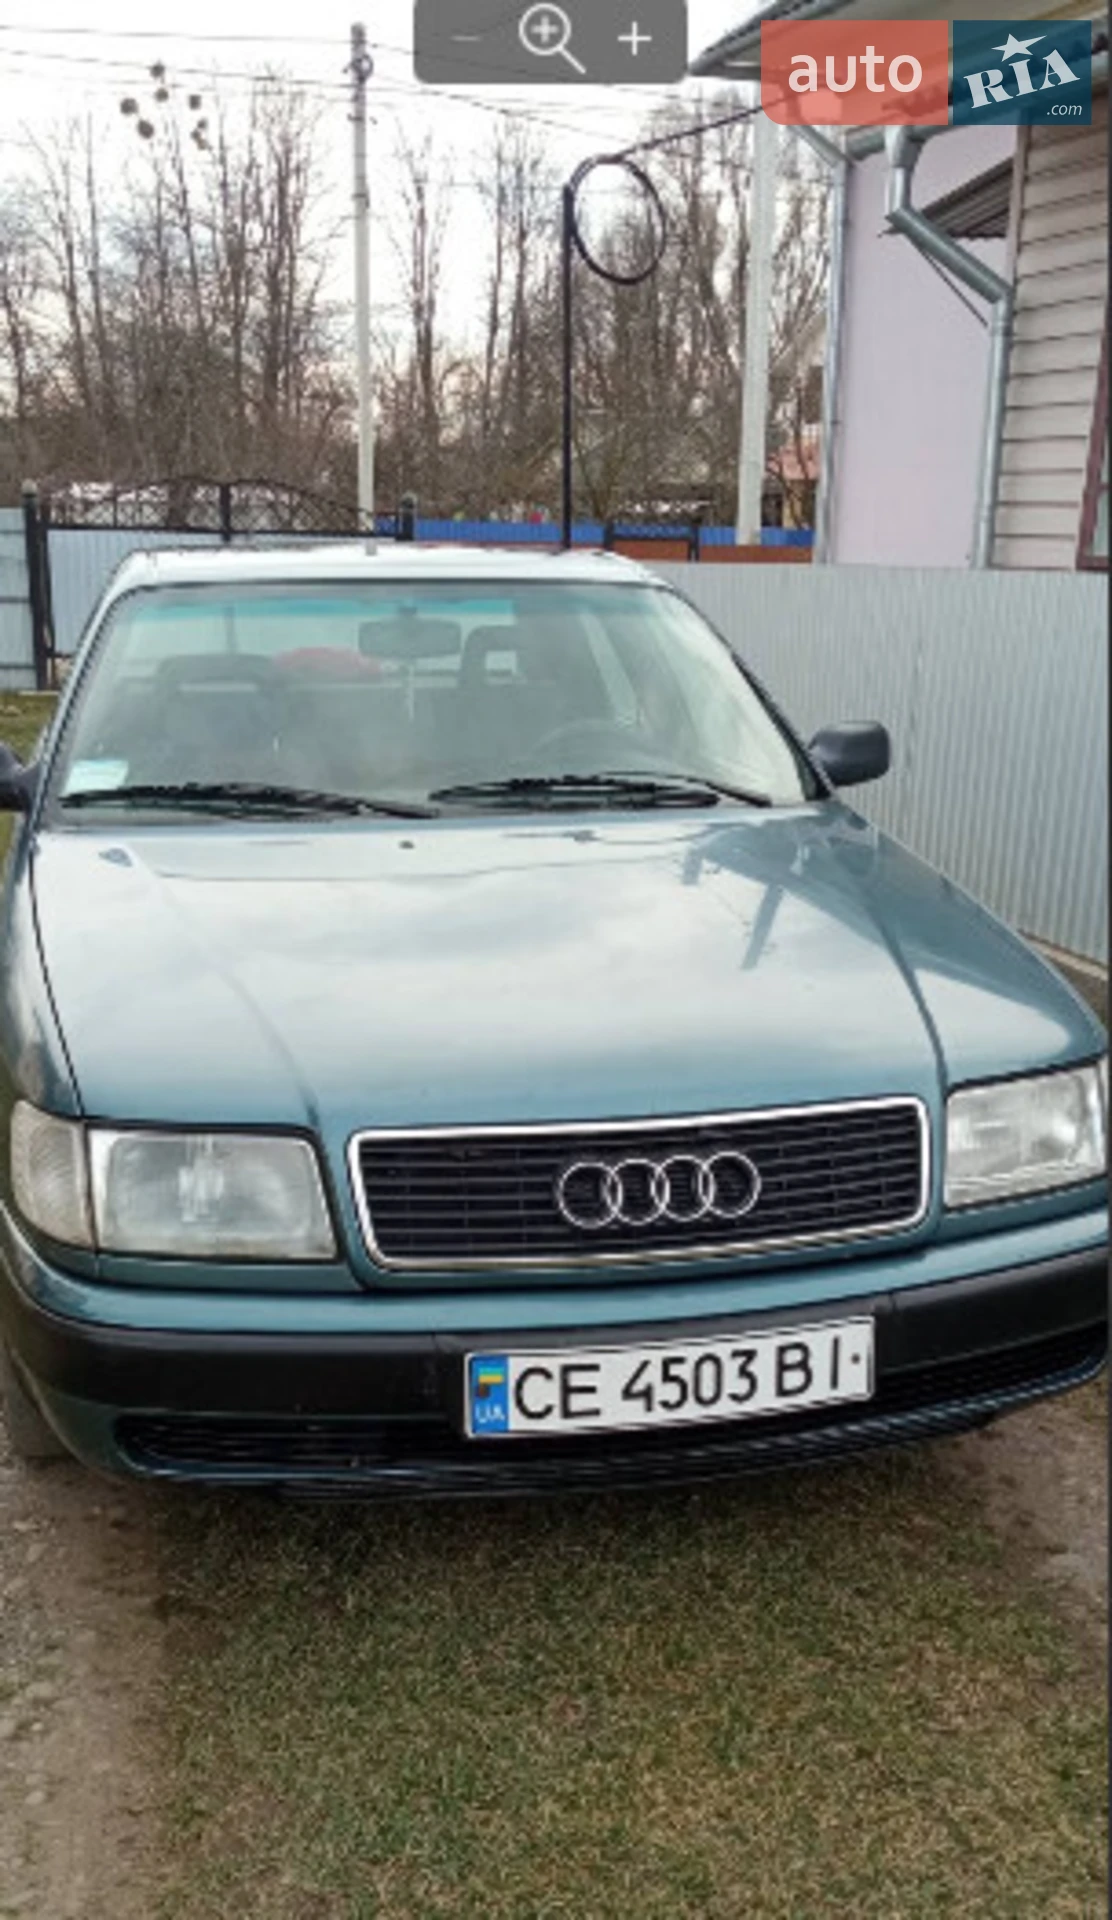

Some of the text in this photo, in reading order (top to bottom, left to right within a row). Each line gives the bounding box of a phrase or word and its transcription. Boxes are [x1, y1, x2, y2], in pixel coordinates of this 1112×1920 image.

[514, 1335, 840, 1420] CE 4503 BI
[475, 1405, 506, 1424] UA
